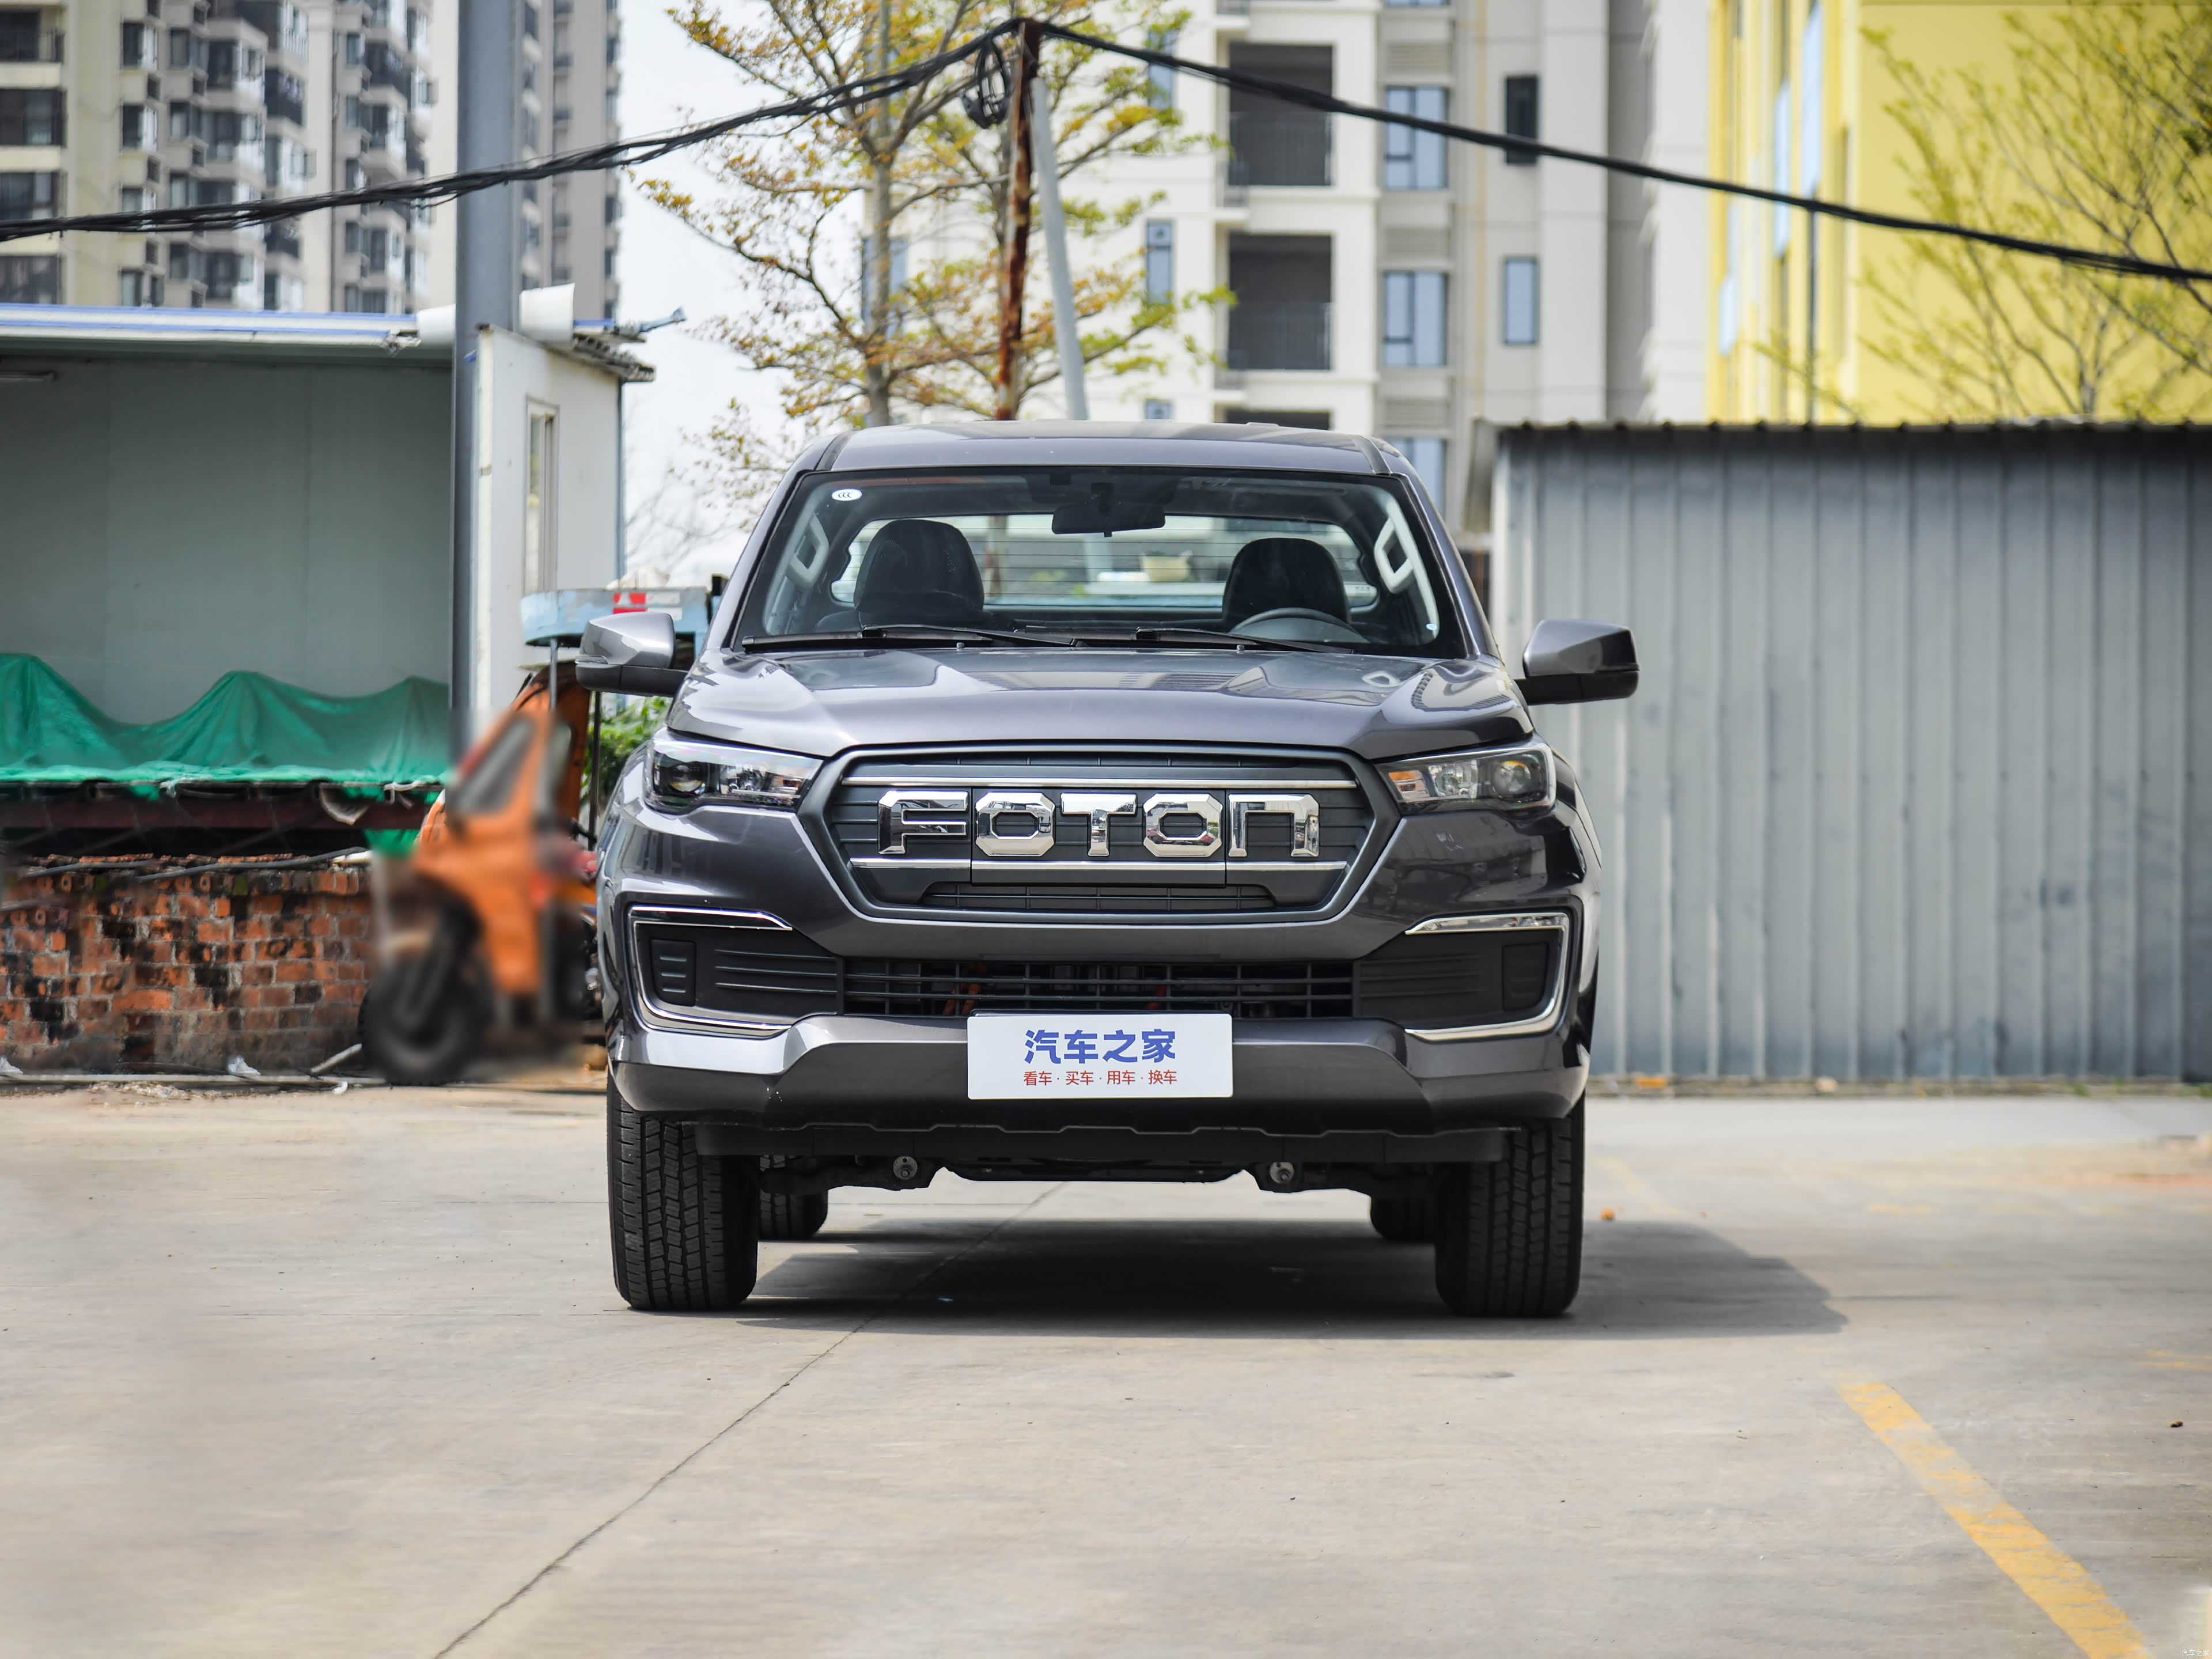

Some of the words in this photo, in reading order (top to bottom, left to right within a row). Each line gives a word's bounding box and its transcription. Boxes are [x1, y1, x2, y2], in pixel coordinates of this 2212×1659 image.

[878, 790, 1320, 857] FOTON
[1024, 1028, 1176, 1065] 汽车之家
